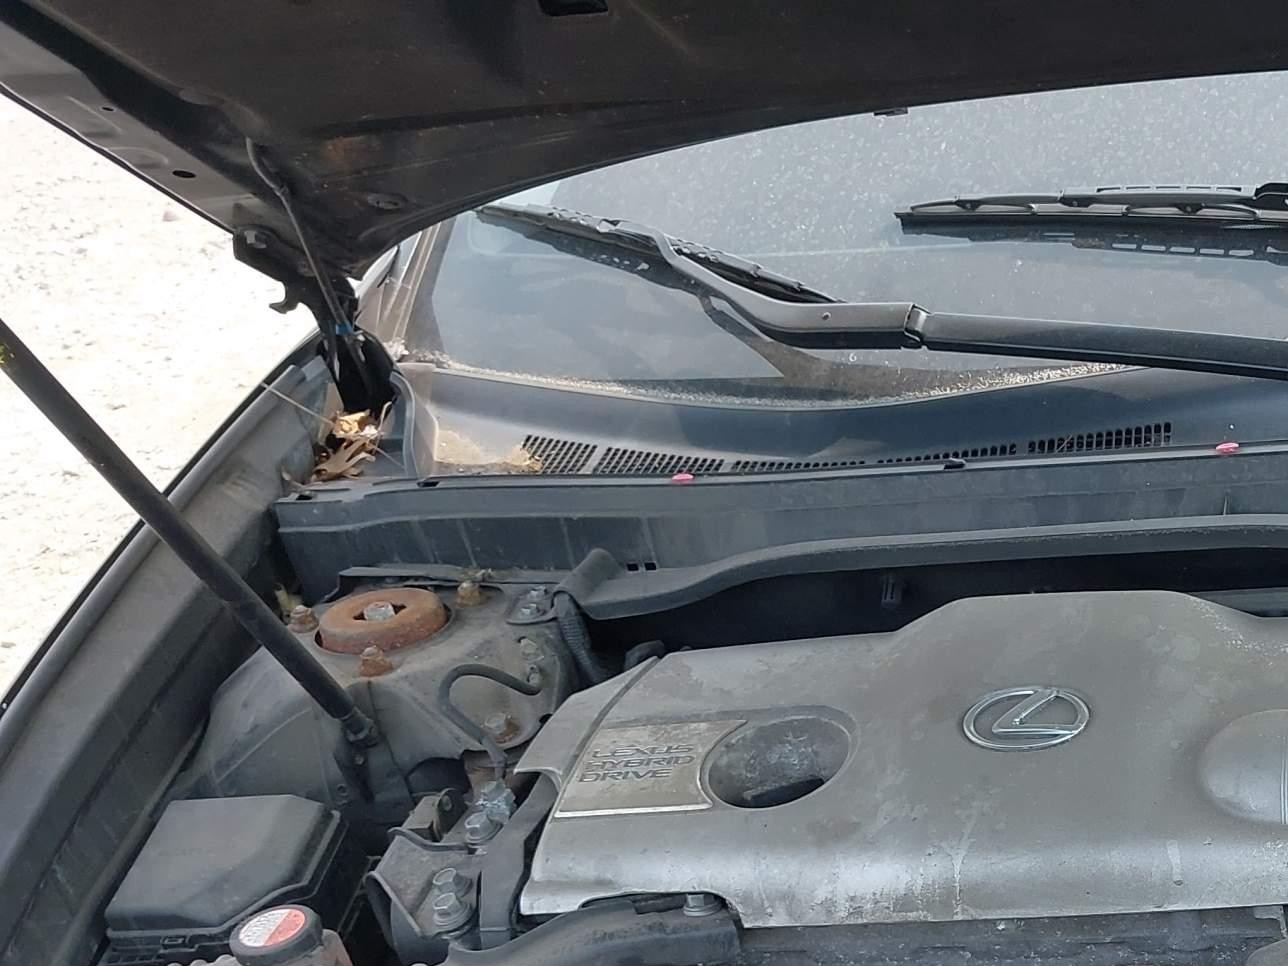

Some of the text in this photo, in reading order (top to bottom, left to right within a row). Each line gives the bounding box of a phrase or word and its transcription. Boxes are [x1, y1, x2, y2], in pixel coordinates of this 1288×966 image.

[592, 744, 694, 758] LEXUS
[585, 755, 695, 770] HYBRID
[579, 769, 672, 782] DRIVE
